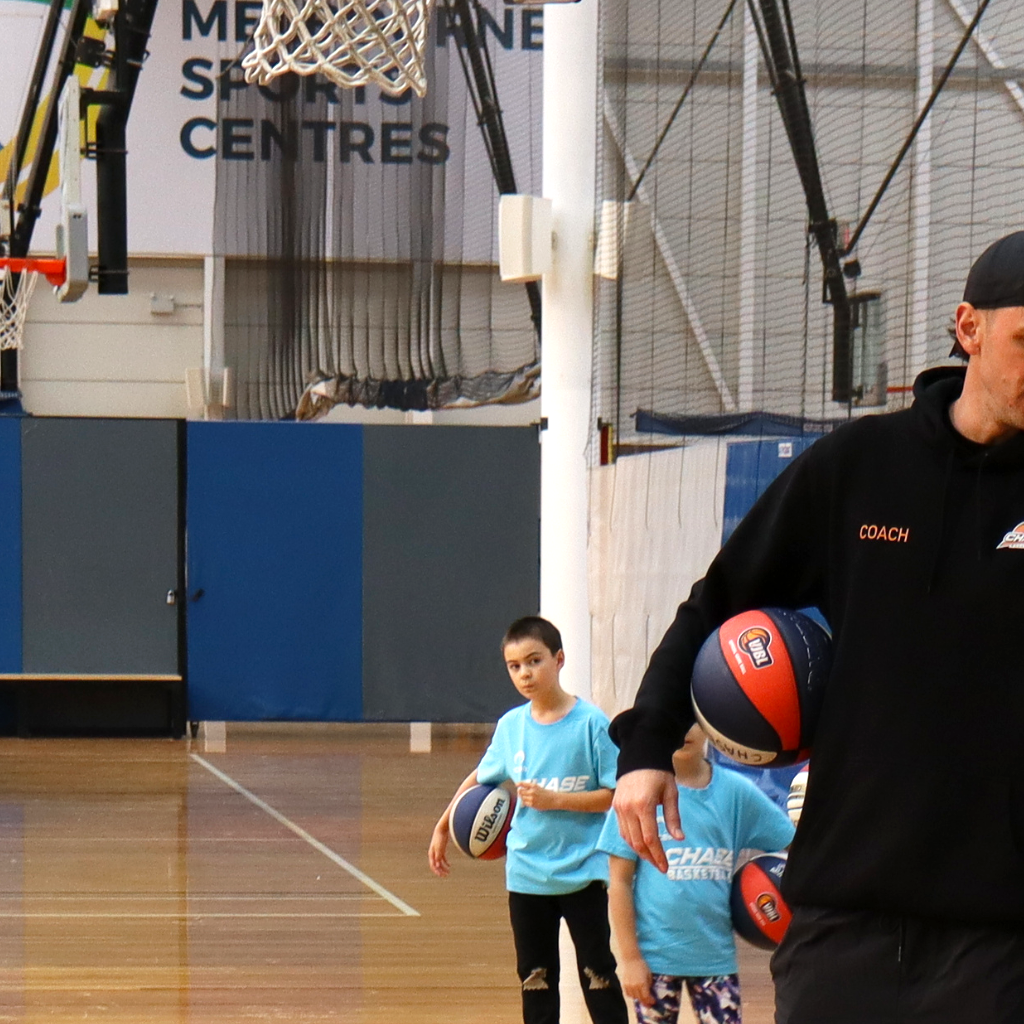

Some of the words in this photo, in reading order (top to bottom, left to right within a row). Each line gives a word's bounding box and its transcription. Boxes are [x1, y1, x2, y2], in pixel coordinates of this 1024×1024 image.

[180, 116, 450, 164] CENTRES
[859, 524, 910, 543] COACH
[526, 775, 590, 793] HASE
[475, 798, 505, 842] Wilson
